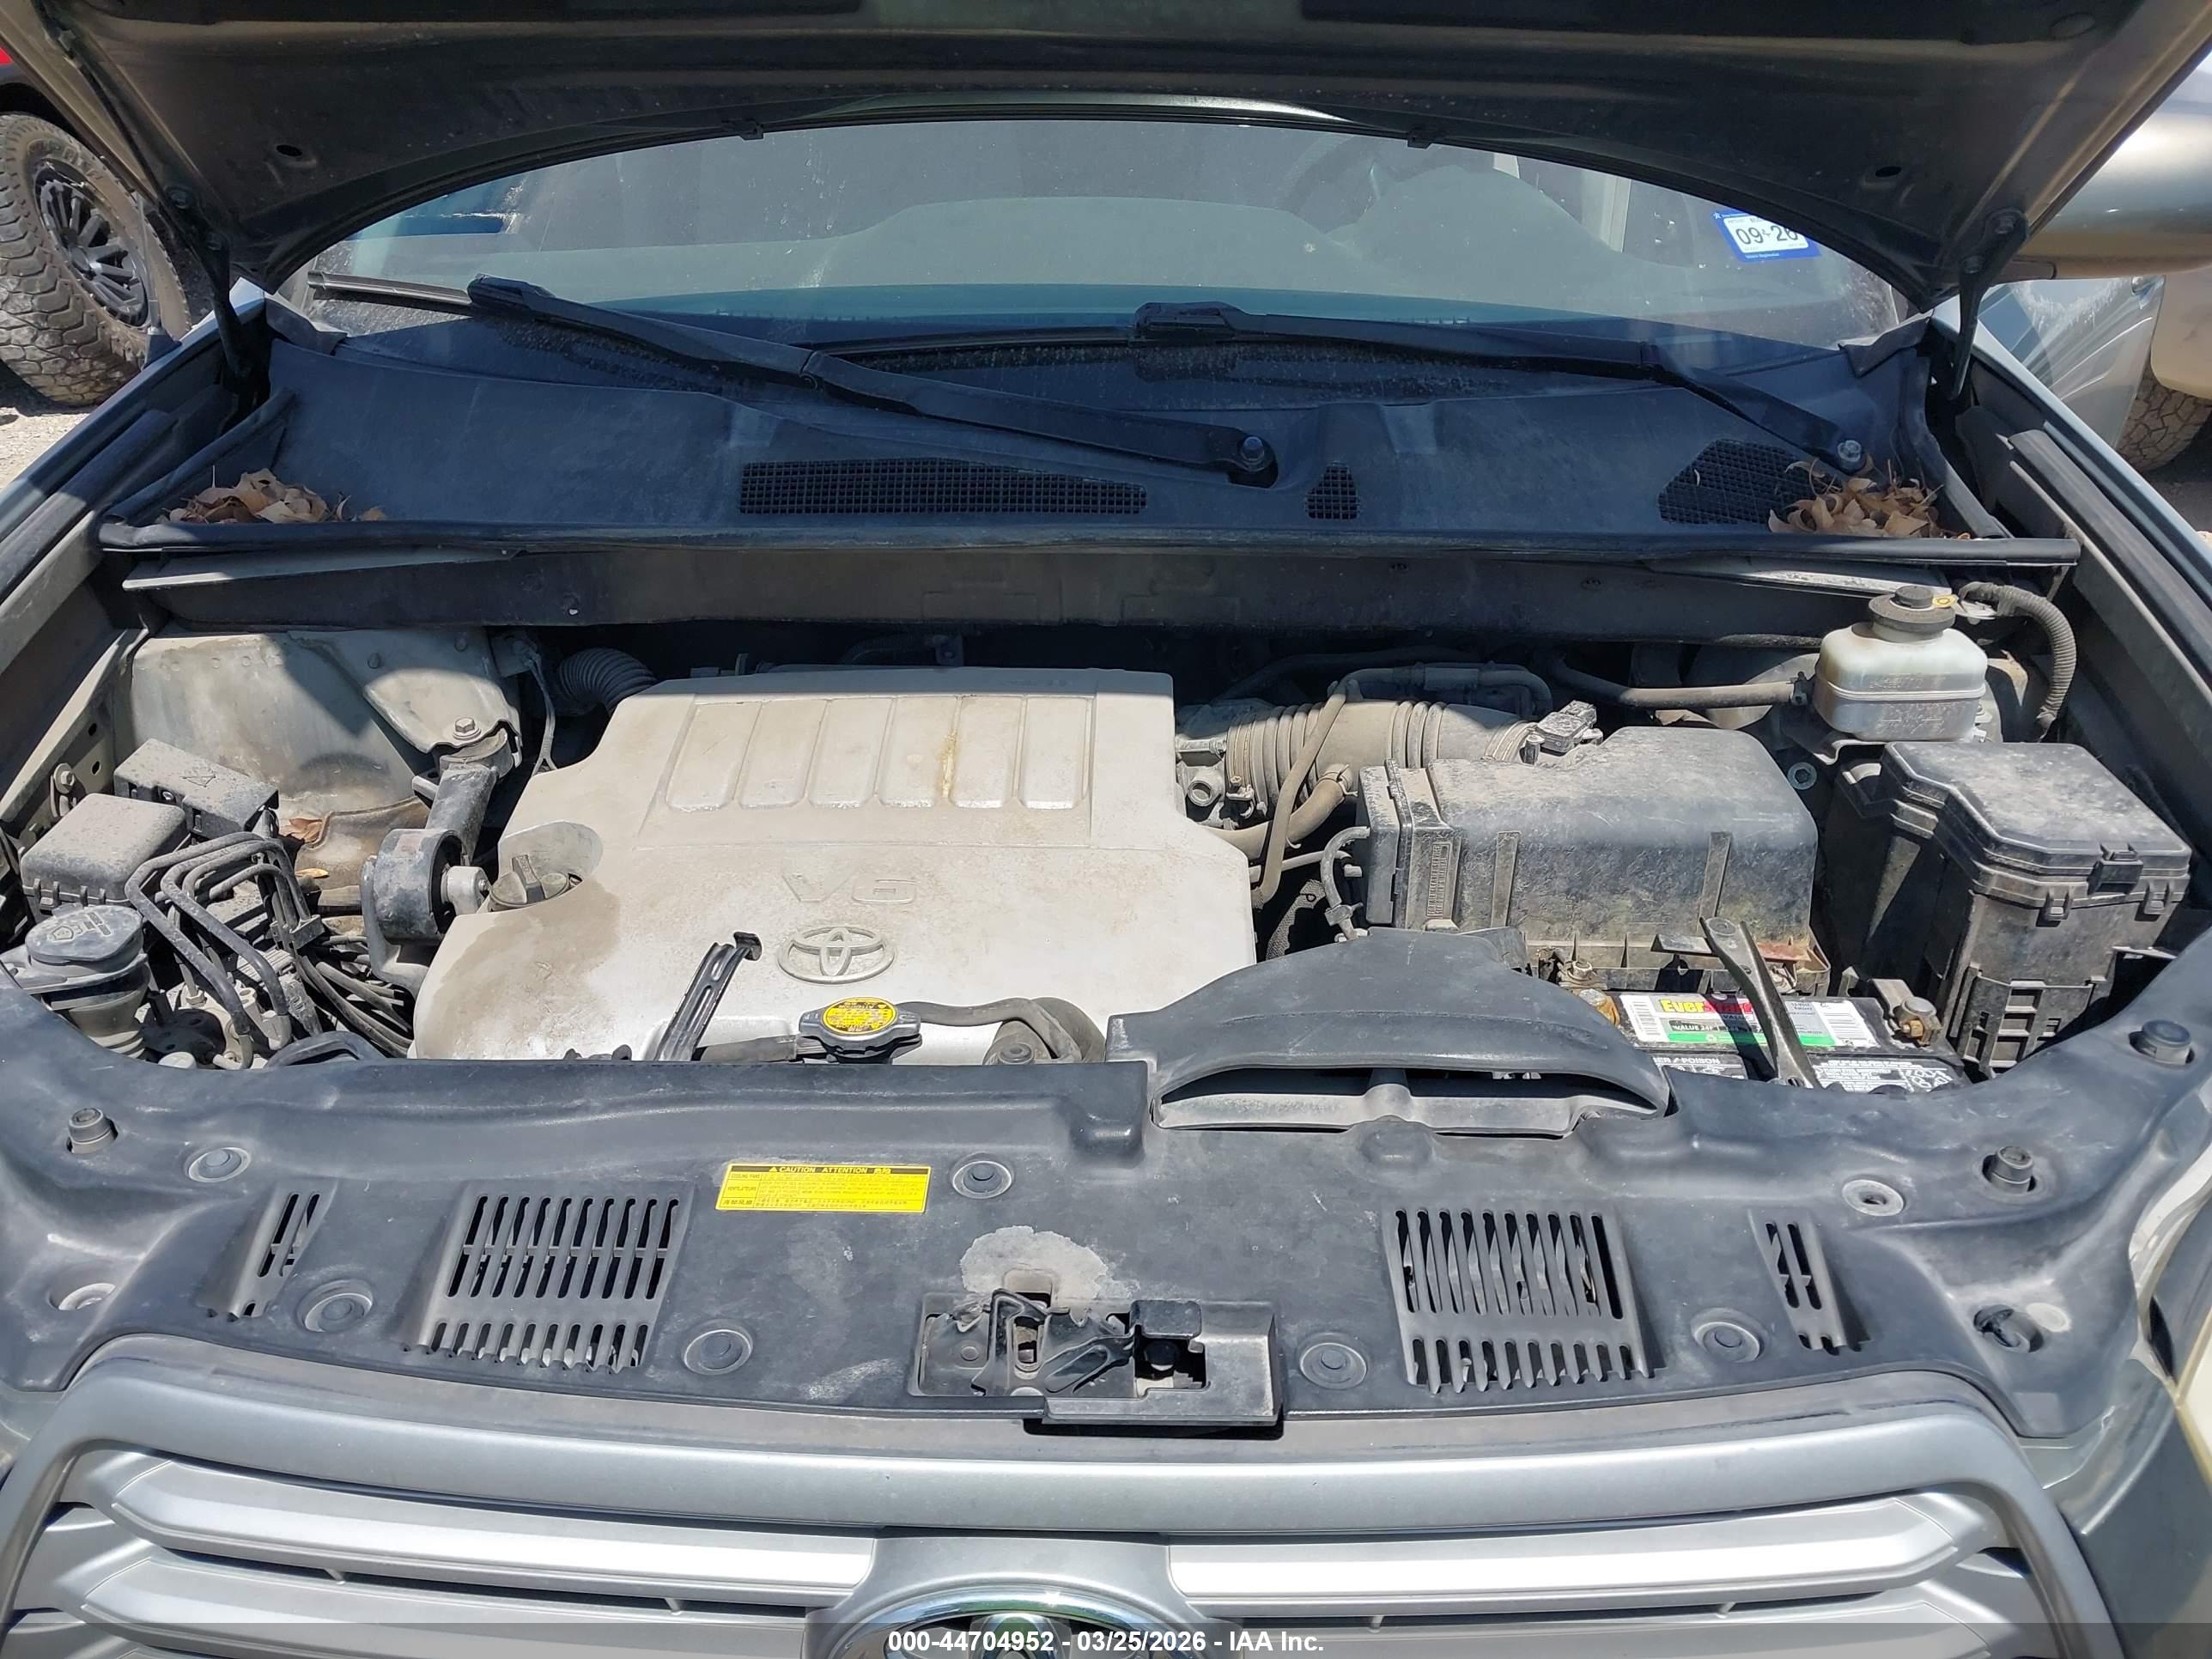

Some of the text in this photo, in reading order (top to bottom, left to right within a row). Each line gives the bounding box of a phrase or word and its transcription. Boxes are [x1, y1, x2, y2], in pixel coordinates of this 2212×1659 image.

[1735, 224, 1799, 245] 09 26
[781, 869, 919, 906] V6
[1660, 999, 1753, 1014] EverStart
